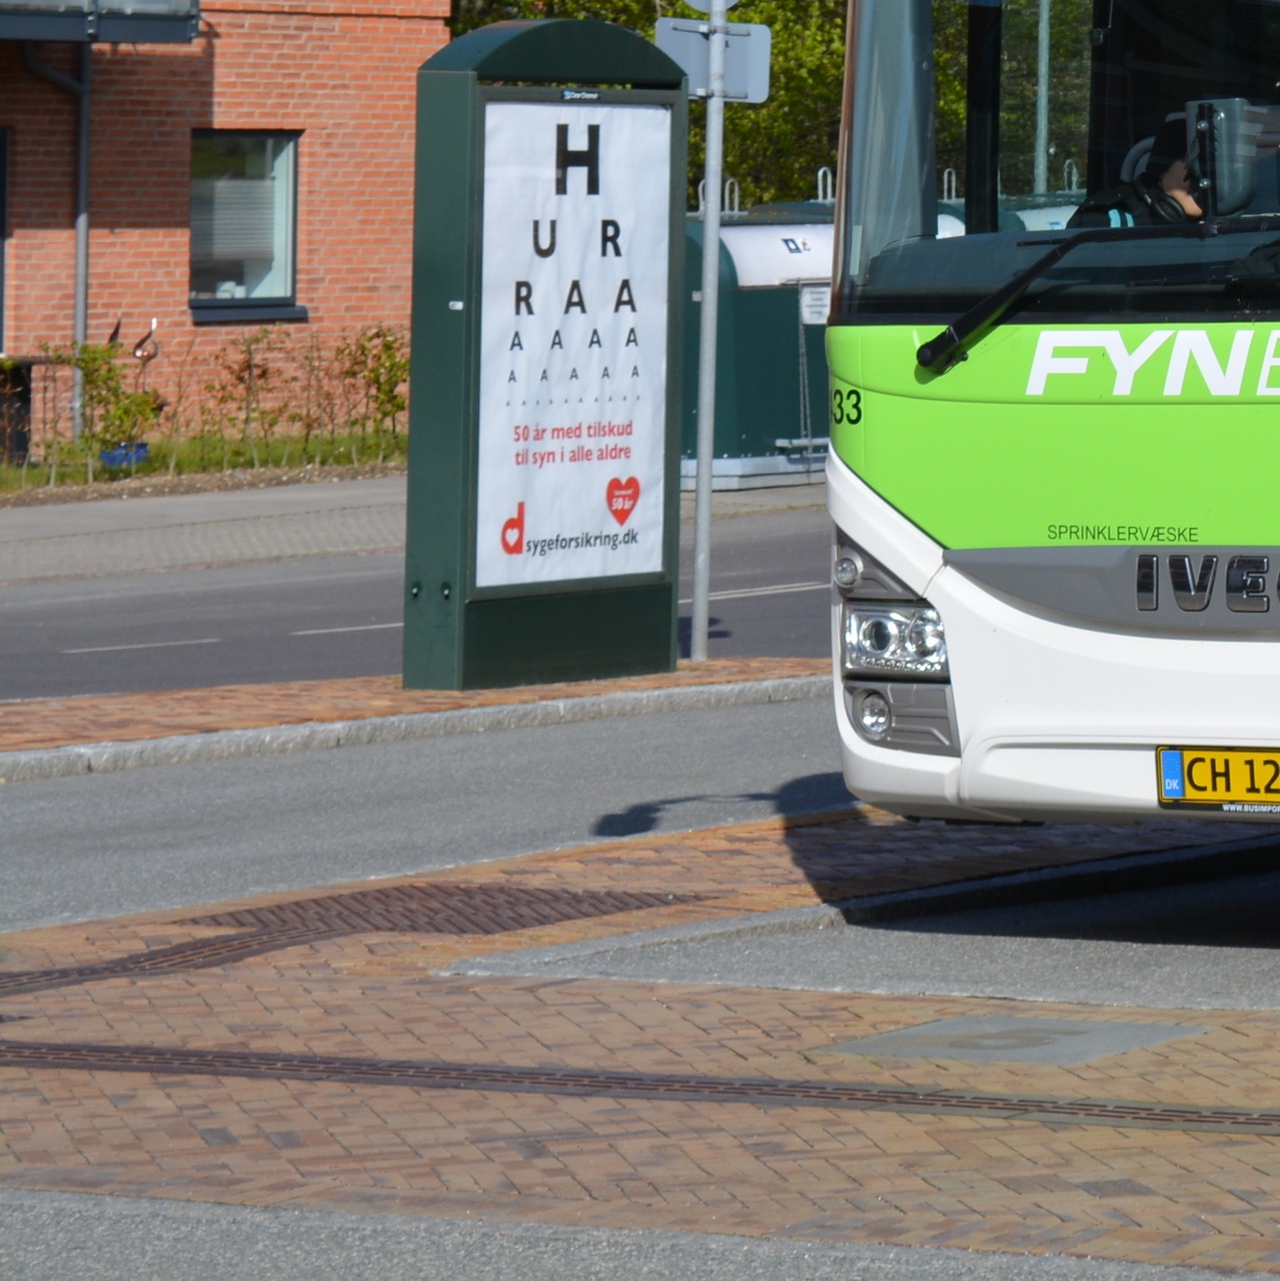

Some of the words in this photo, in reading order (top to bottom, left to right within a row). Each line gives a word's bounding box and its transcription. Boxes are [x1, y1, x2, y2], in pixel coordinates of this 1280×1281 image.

[556, 123, 600, 195] H
[533, 219, 556, 259] U
[601, 219, 622, 257] R
[514, 280, 535, 316] R
[563, 279, 588, 315] A
[613, 278, 638, 314] A
[509, 330, 524, 352] A
[550, 329, 563, 350] A
[588, 328, 602, 349] A
[625, 327, 639, 348] A
[508, 370, 517, 383] A
[540, 369, 548, 382] A
[570, 367, 579, 381] A
[602, 366, 610, 379] A
[631, 365, 639, 378] A
[831, 388, 863, 426] 33
[513, 424, 530, 443] 50
[533, 422, 547, 441] år
[551, 422, 583, 440] med
[586, 419, 633, 439] tilskud
[514, 448, 529, 466] til
[532, 450, 556, 469] syn
[560, 446, 564, 463] i
[569, 445, 593, 463] alle
[596, 443, 631, 461] aldre
[526, 527, 639, 557] sygeforsikring.dk
[1046, 524, 1200, 543] SPRINKLERVÆSKE
[1165, 778, 1180, 791] DK
[1186, 756, 1232, 793] CH
